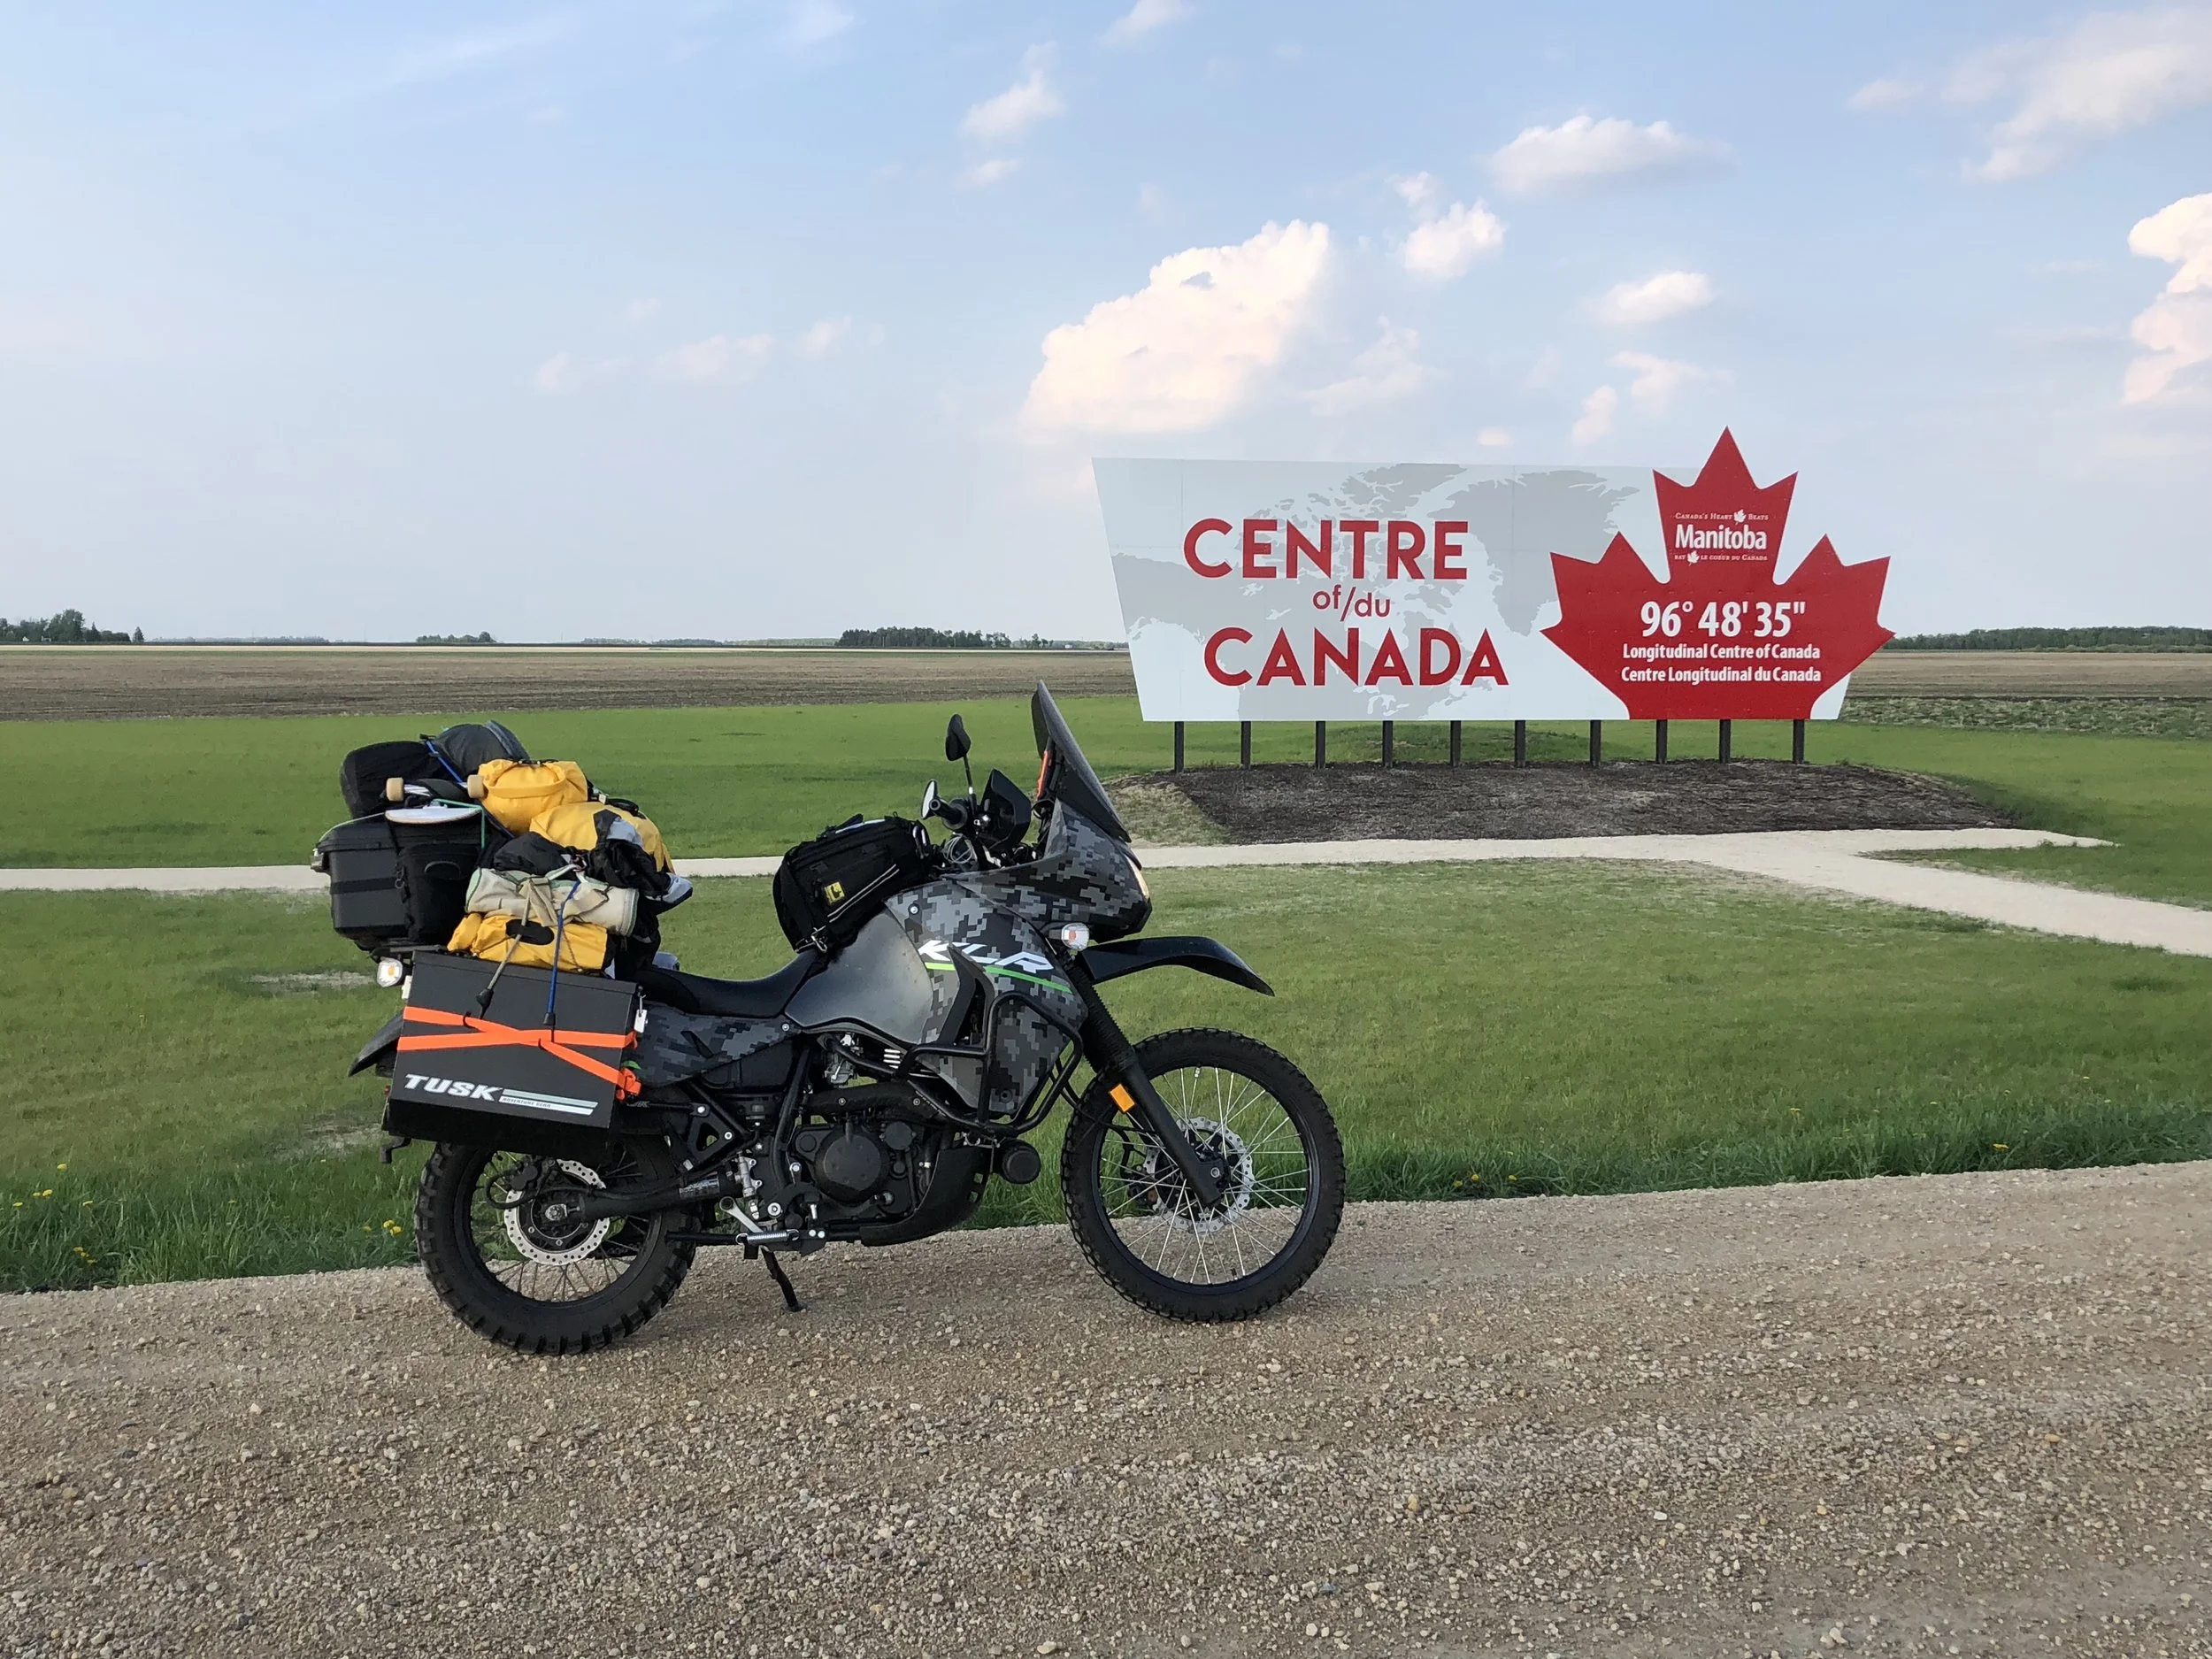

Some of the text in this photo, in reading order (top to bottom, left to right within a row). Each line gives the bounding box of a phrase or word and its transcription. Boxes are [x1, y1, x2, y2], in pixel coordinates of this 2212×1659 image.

[1183, 518, 1469, 580] CENTRE
[1675, 524, 1767, 549] Manitoba
[1312, 584, 1391, 622] of/du
[1640, 601, 1806, 638] 96° 48' 35"
[1203, 626, 1509, 687] CANADA
[1623, 643, 1821, 663] Longitudinal Centre of Canada
[1621, 666, 1822, 686] Centre Longitudinal du Canada
[918, 940, 1055, 973] KLR
[404, 1073, 503, 1102] TUSK
